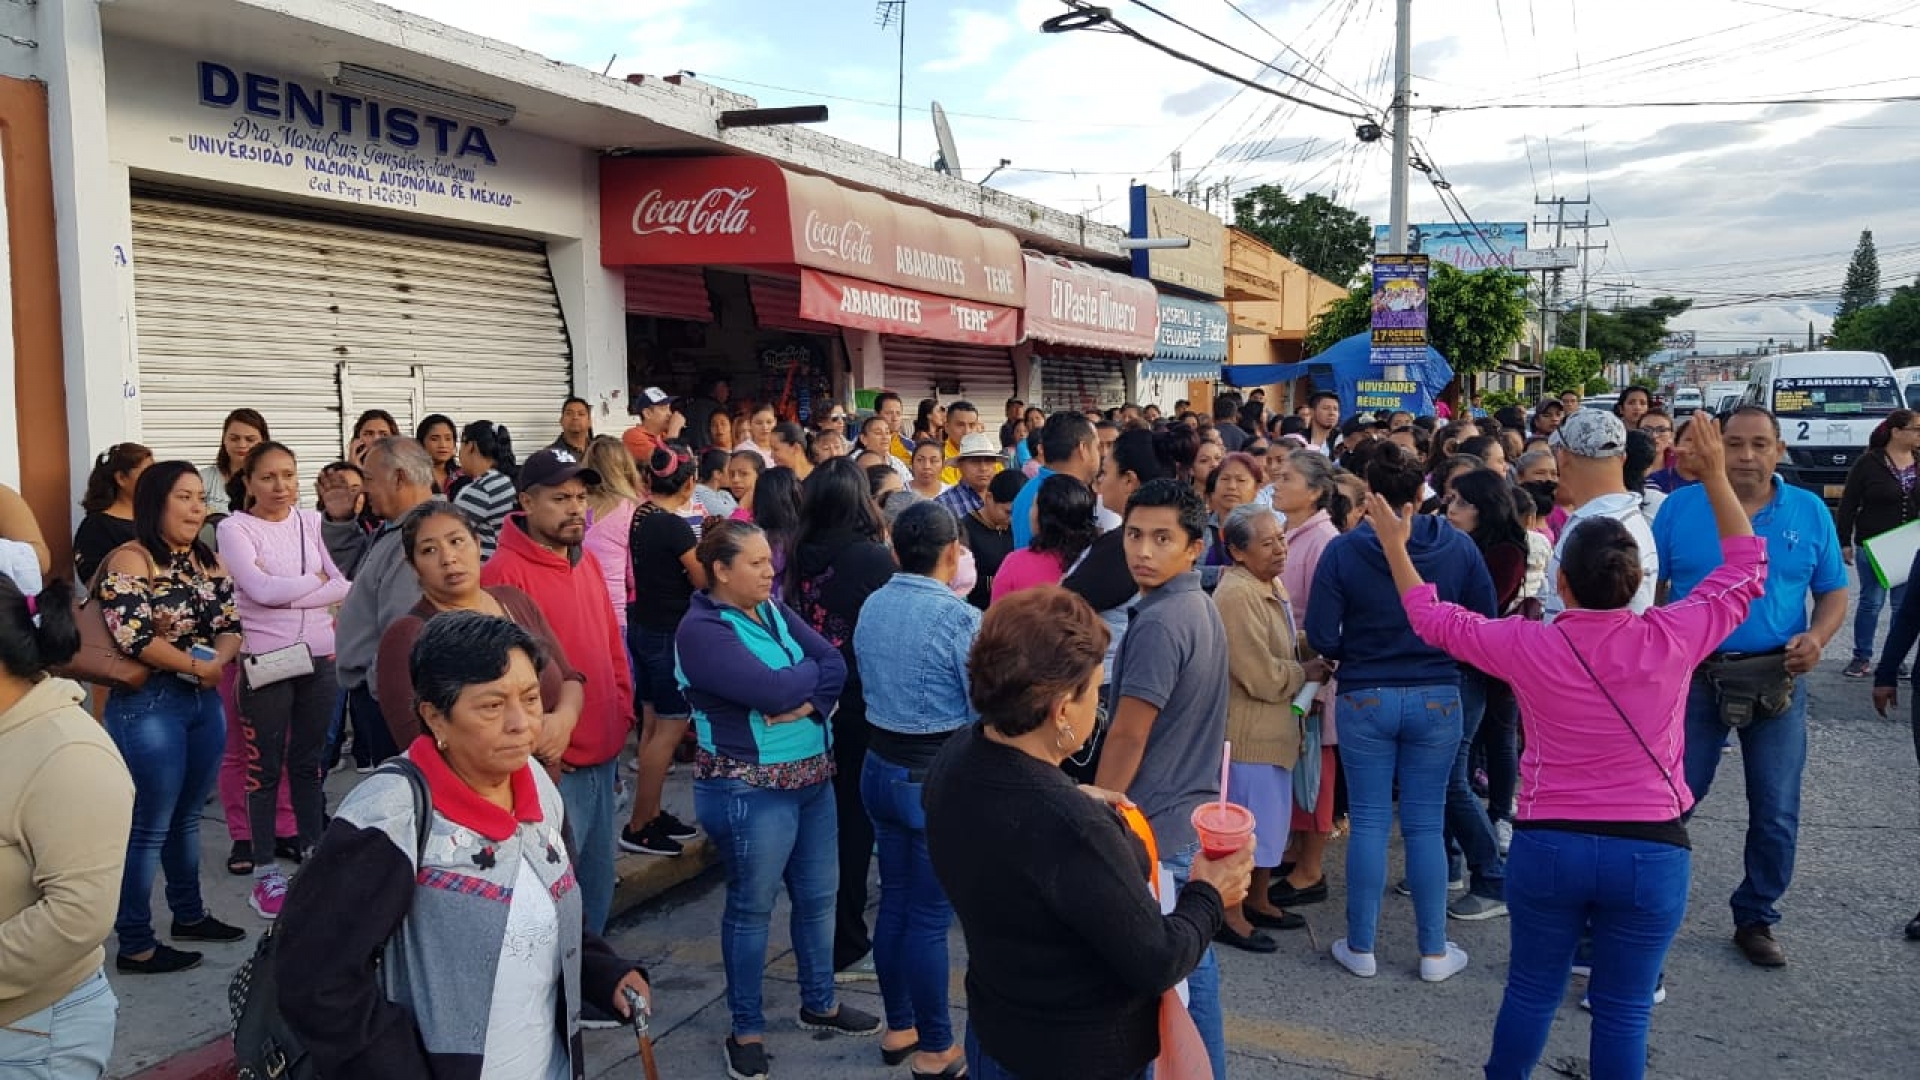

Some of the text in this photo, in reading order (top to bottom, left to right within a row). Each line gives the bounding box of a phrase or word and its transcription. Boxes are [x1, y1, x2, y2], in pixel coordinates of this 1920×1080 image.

[198, 61, 497, 166] DENTISTA
[188, 133, 294, 167] UNIVERSIDAD
[305, 155, 374, 182] NACIONAL
[451, 180, 466, 199] DE
[896, 245, 1014, 295] ABARROTES TERE
[840, 286, 994, 332] ABARROTES "TERE"
[1051, 278, 1063, 319] El
[1064, 281, 1098, 325] Paste
[1356, 381, 1417, 394] NOVEDADES
[1356, 395, 1401, 408] REGALOS
[1796, 378, 1870, 387] ZARAGOZA
[1796, 421, 1809, 441] 2
